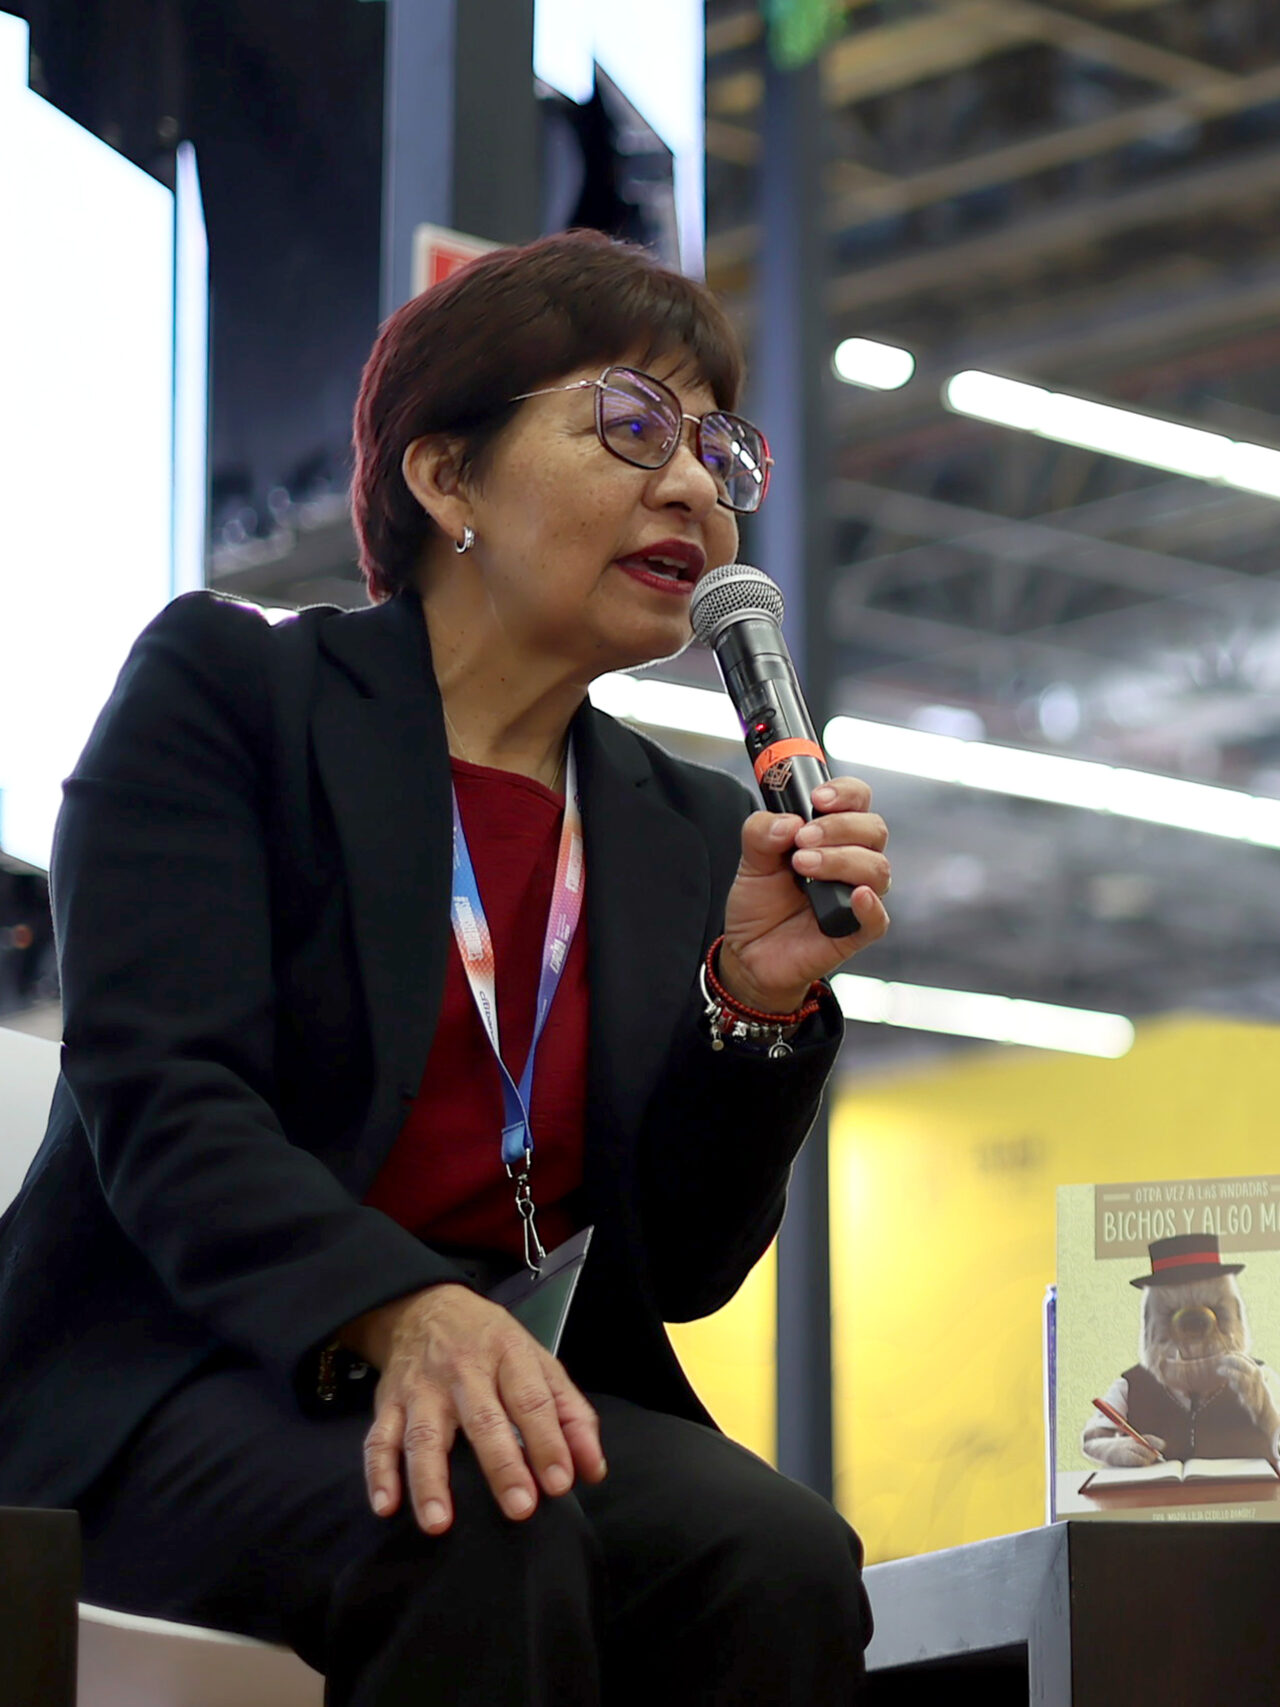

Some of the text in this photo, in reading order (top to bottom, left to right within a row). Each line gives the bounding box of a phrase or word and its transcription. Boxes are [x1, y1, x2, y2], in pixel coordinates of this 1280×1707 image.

[1136, 1181, 1269, 1203] OTRA VEZ A LAS ANDADAS
[1104, 1208, 1176, 1242] BICHOS
[1183, 1208, 1195, 1235] Y
[1202, 1204, 1252, 1236] ALGO
